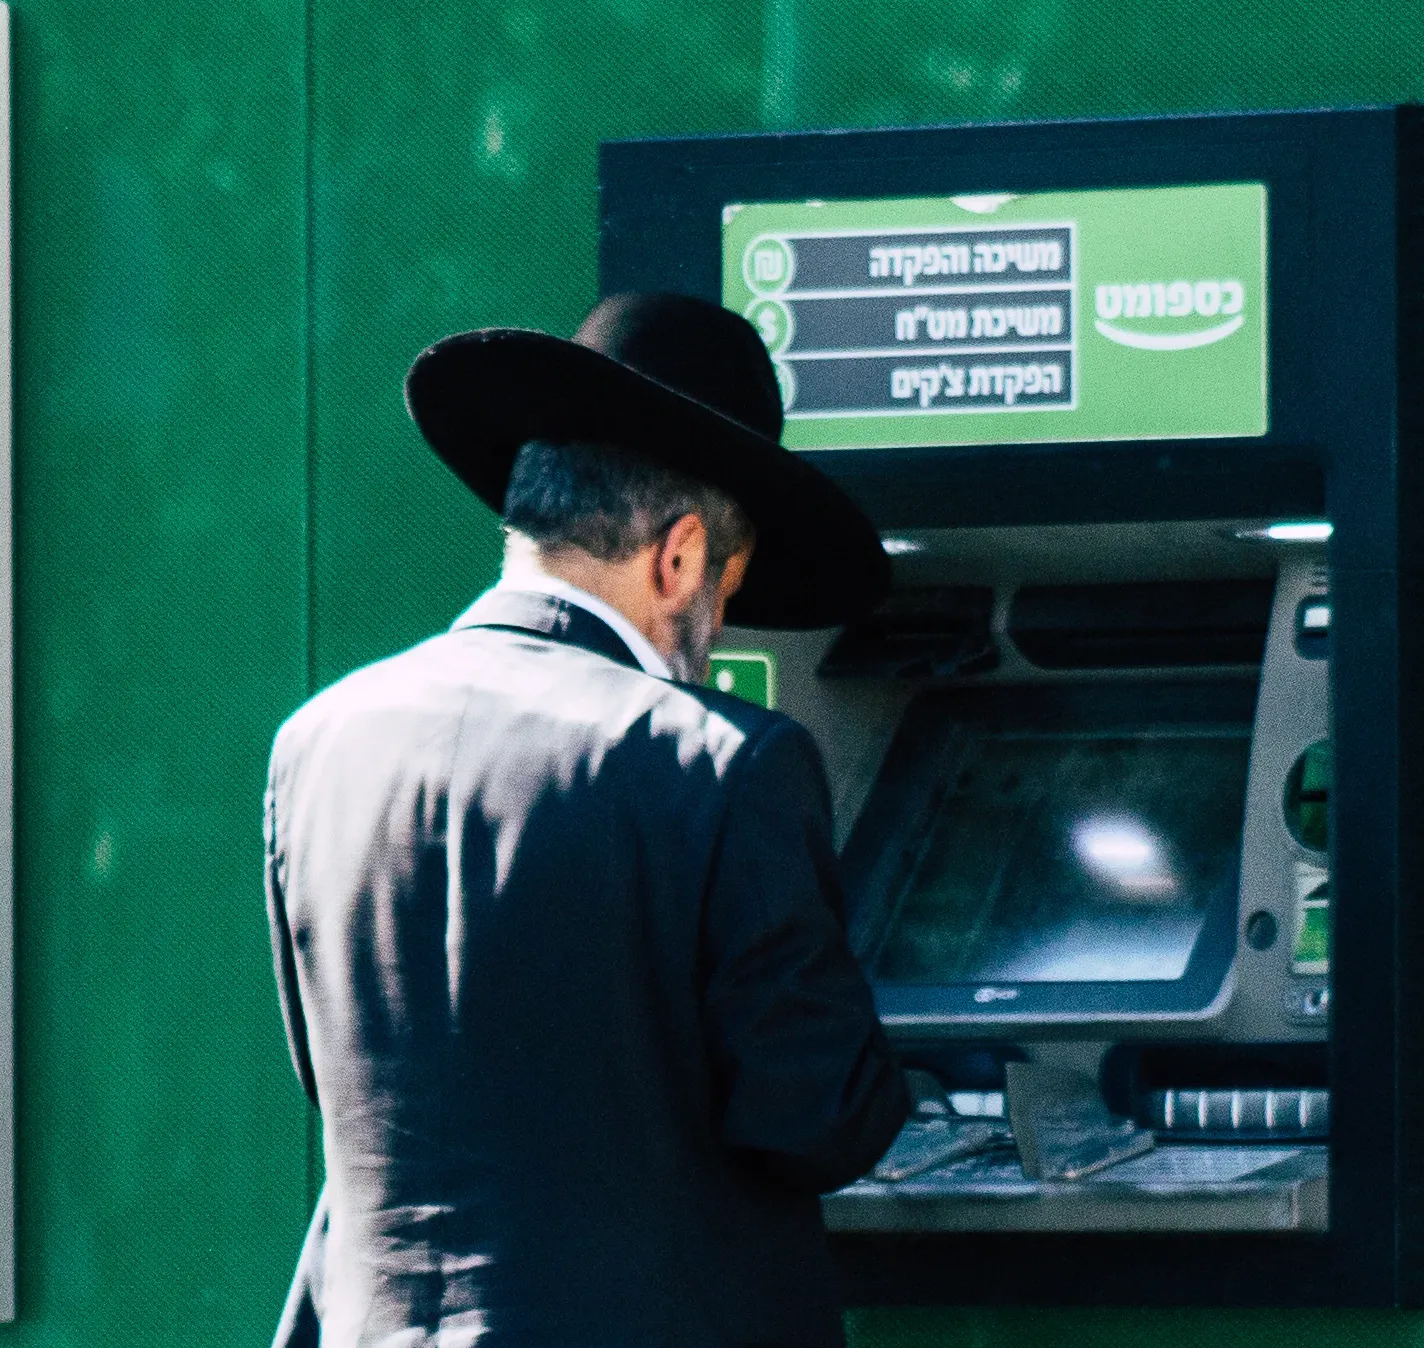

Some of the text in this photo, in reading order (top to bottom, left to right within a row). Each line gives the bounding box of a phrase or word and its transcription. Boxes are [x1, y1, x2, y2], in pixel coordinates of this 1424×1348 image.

[868, 241, 1062, 287] משיכה והפקדה
[1094, 279, 1245, 319] כספומט
[971, 306, 1063, 339] משיכת
[970, 363, 1062, 407] הפקדת
